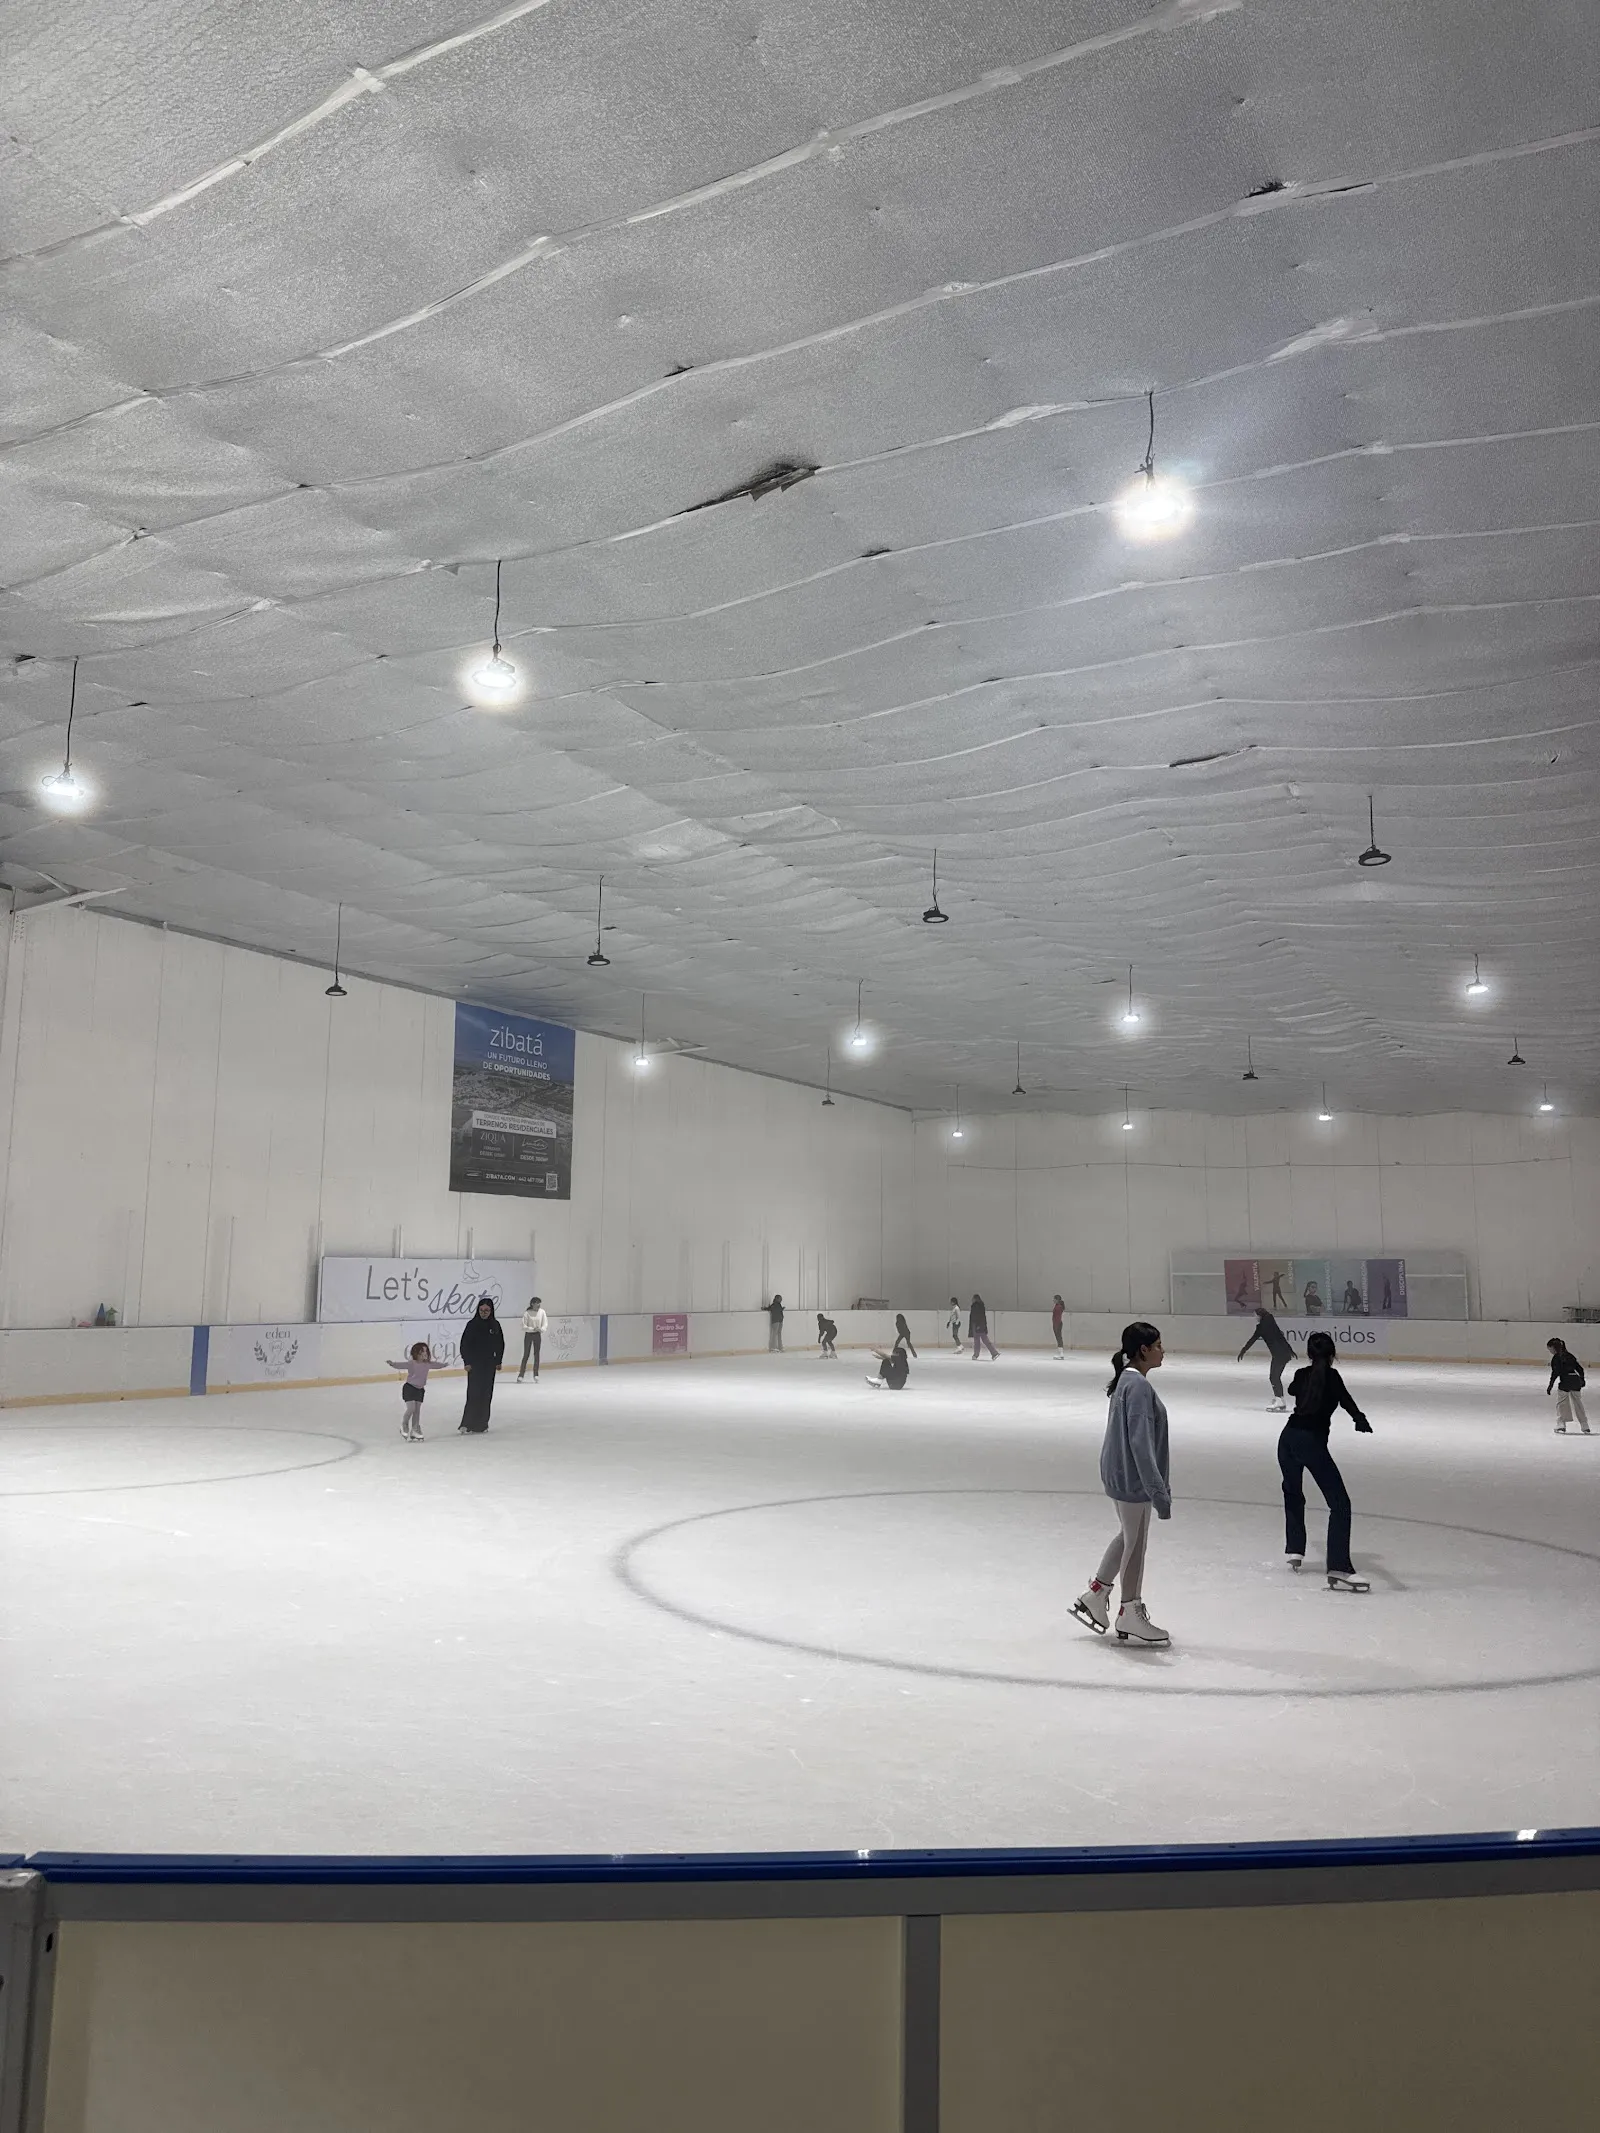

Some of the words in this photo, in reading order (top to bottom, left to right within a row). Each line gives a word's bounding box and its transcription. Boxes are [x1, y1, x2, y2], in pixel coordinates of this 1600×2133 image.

[490, 1026, 544, 1056] zibatá
[487, 1051, 497, 1060] UN
[499, 1053, 525, 1066] FUTURO
[527, 1058, 548, 1070] LLENO
[483, 1061, 493, 1070] DE
[494, 1063, 551, 1081] OPORTUNIDADES
[475, 1118, 507, 1130] TERRENOS
[509, 1123, 554, 1135] RESIDENCIALES
[485, 1173, 516, 1181] ZIBATA.COM
[366, 1265, 429, 1301] Let's
[1398, 1261, 1406, 1296] DISCIPLINA
